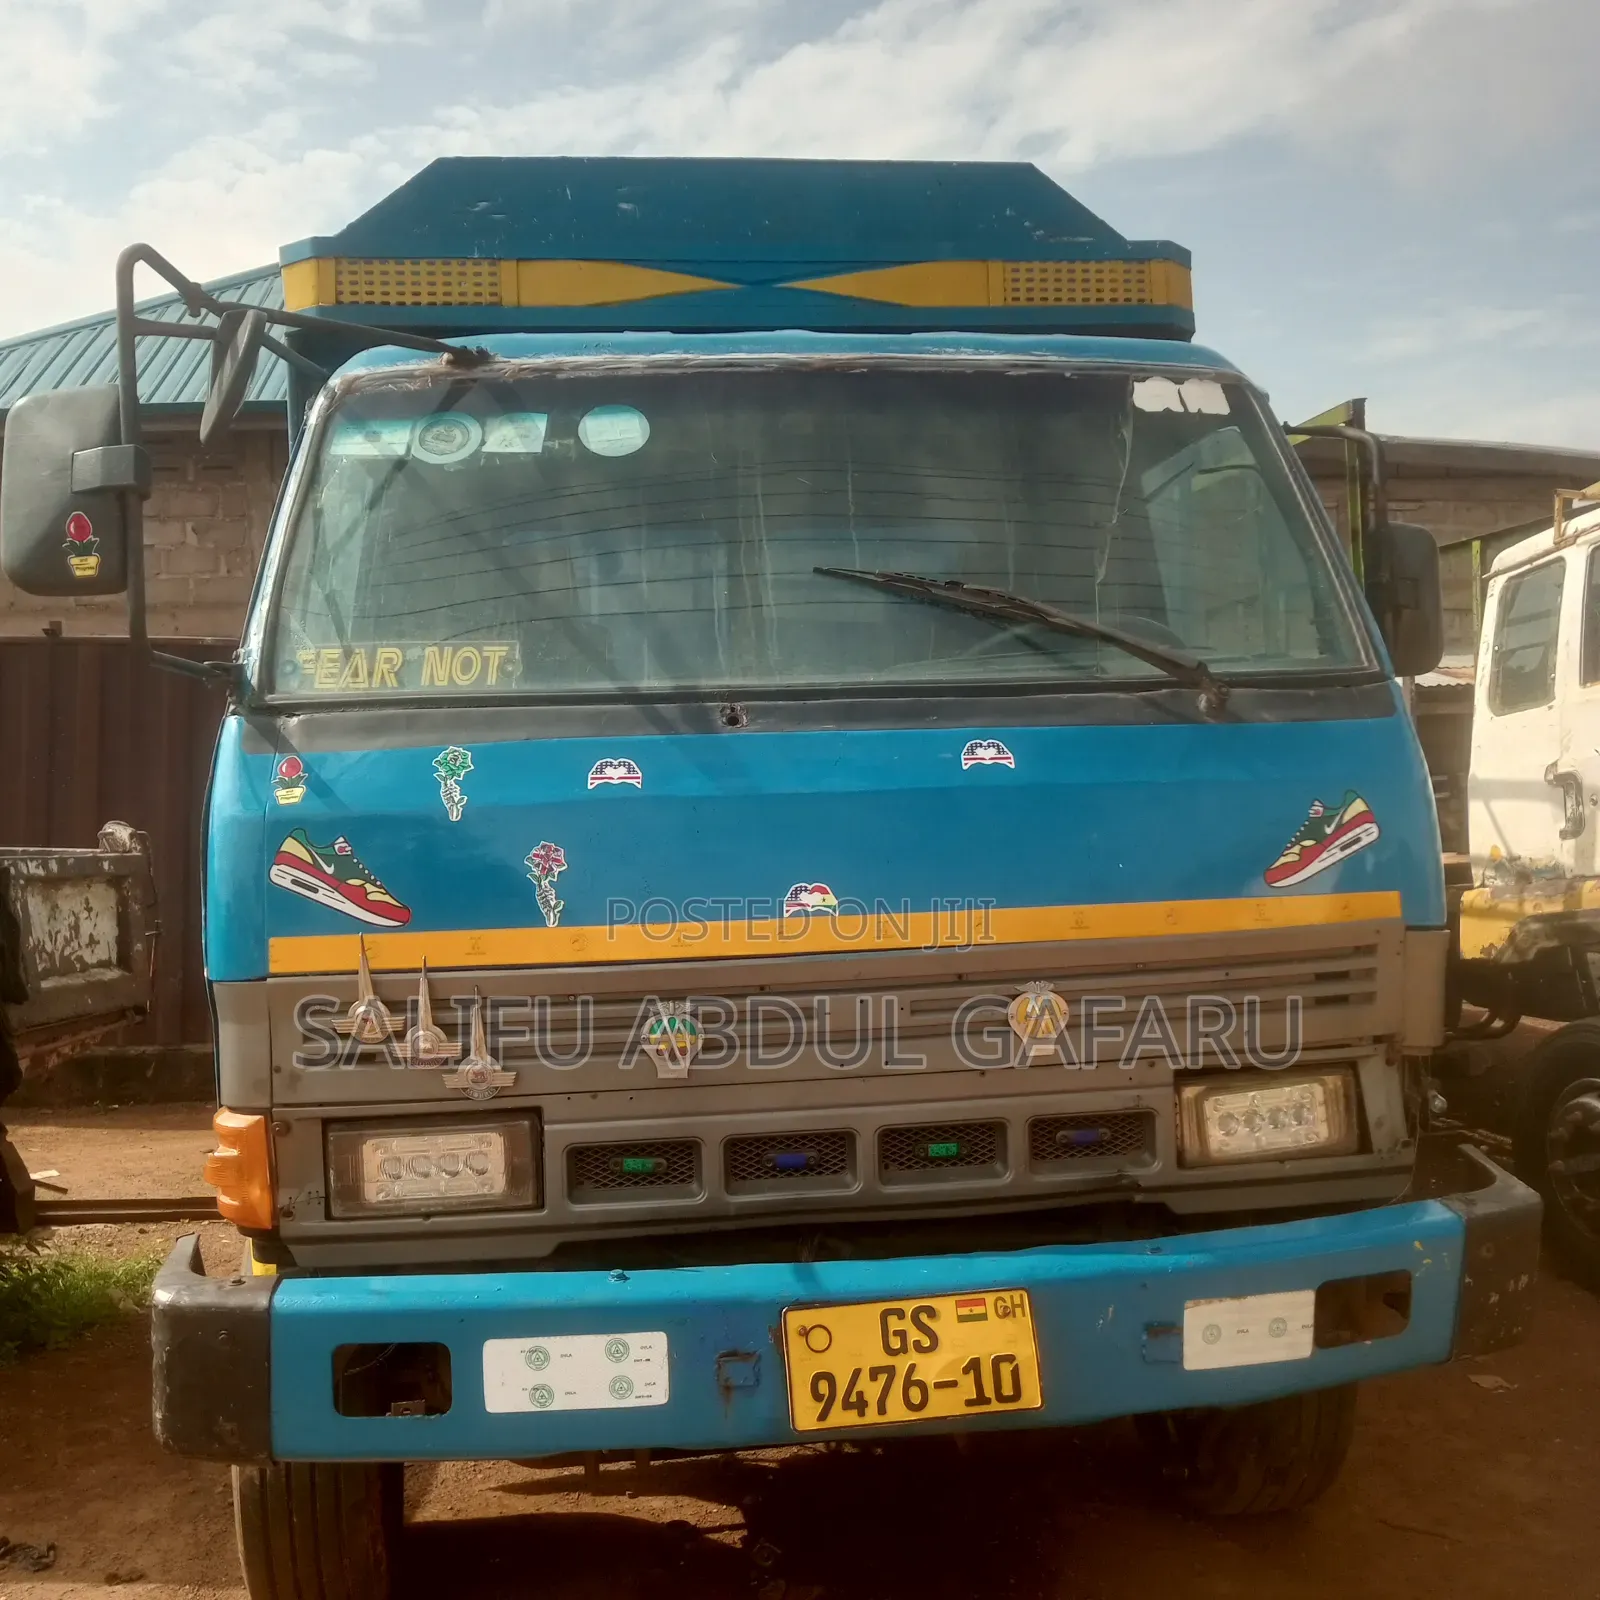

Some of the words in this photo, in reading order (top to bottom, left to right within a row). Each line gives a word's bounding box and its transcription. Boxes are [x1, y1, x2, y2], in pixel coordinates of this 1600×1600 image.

[420, 645, 510, 687] NOT
[993, 1293, 1027, 1320] GH
[879, 1304, 940, 1357] GS
[809, 1353, 1022, 1422] 9476-10
